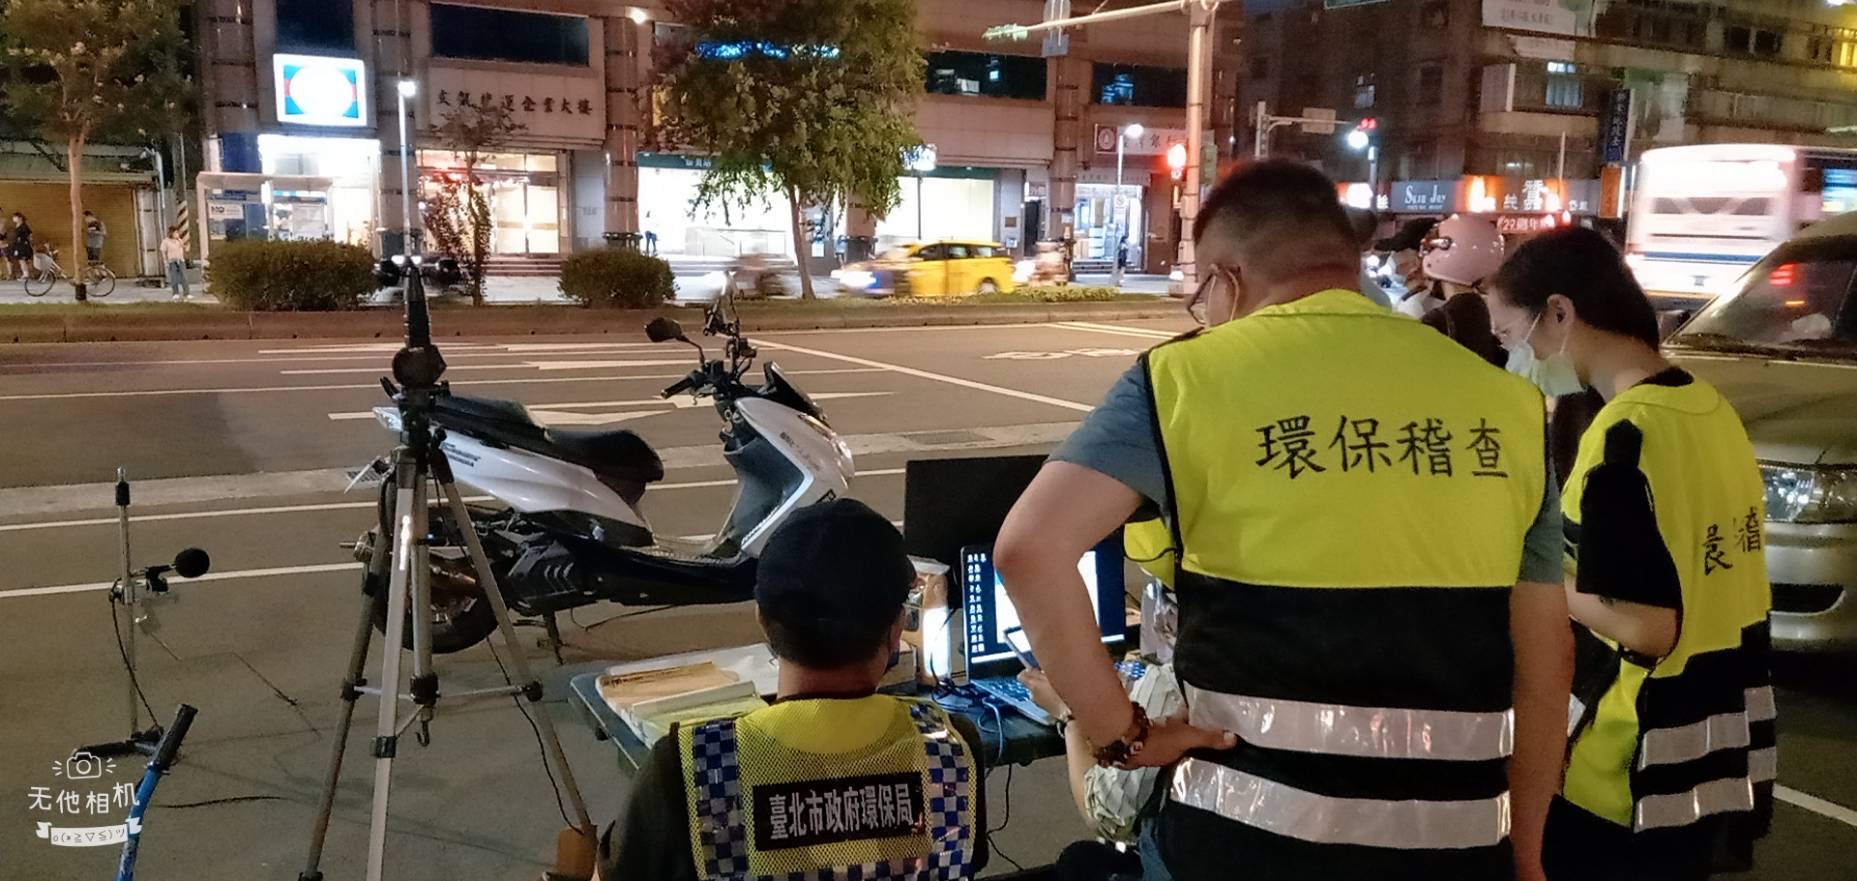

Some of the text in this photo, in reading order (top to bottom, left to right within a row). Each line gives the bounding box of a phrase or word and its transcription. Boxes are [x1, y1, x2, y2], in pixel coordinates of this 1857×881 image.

[1255, 415, 1508, 480] 環保稽查
[769, 783, 914, 840] 臺北市政府環保局
